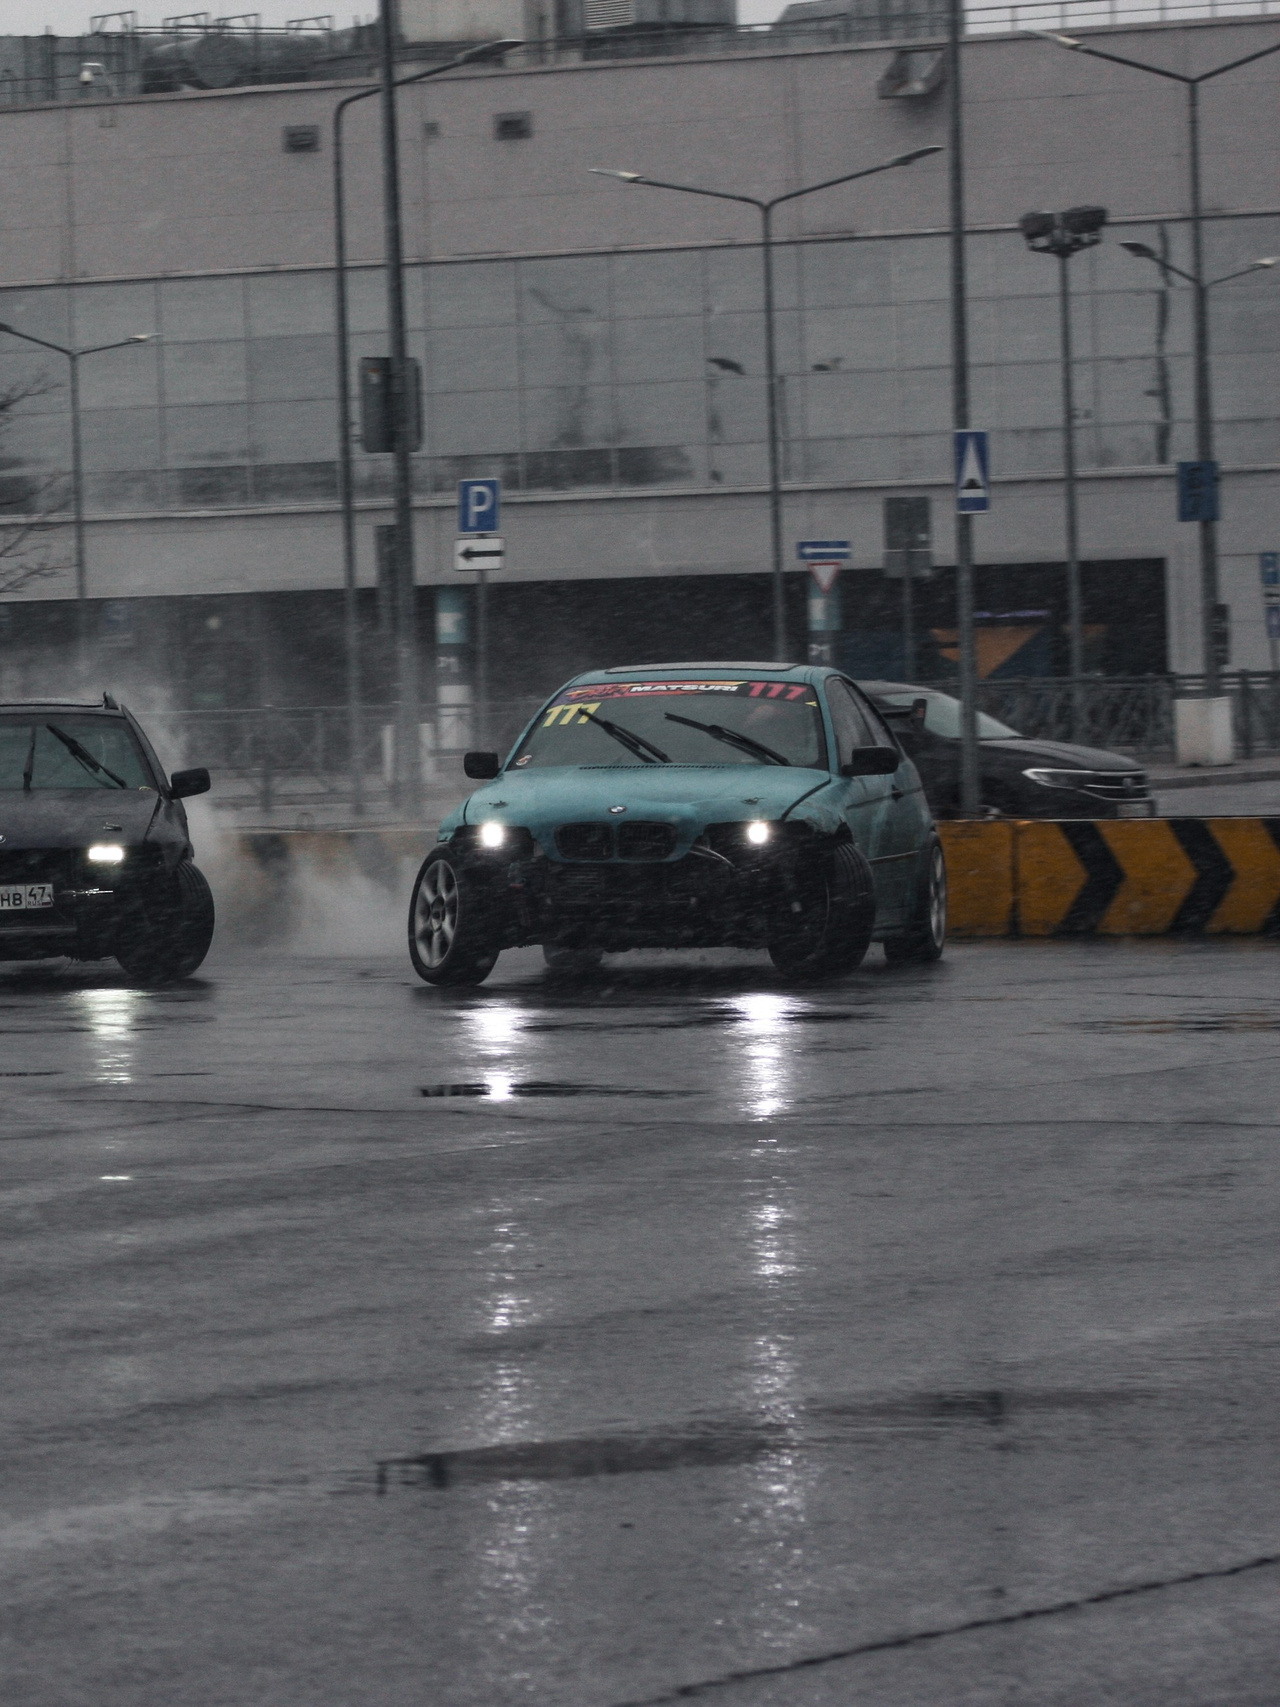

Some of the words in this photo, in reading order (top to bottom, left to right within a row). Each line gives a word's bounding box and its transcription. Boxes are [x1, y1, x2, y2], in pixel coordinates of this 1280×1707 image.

[468, 485, 494, 528] P
[631, 684, 739, 692] MATSURI
[28, 886, 46, 900] 47
